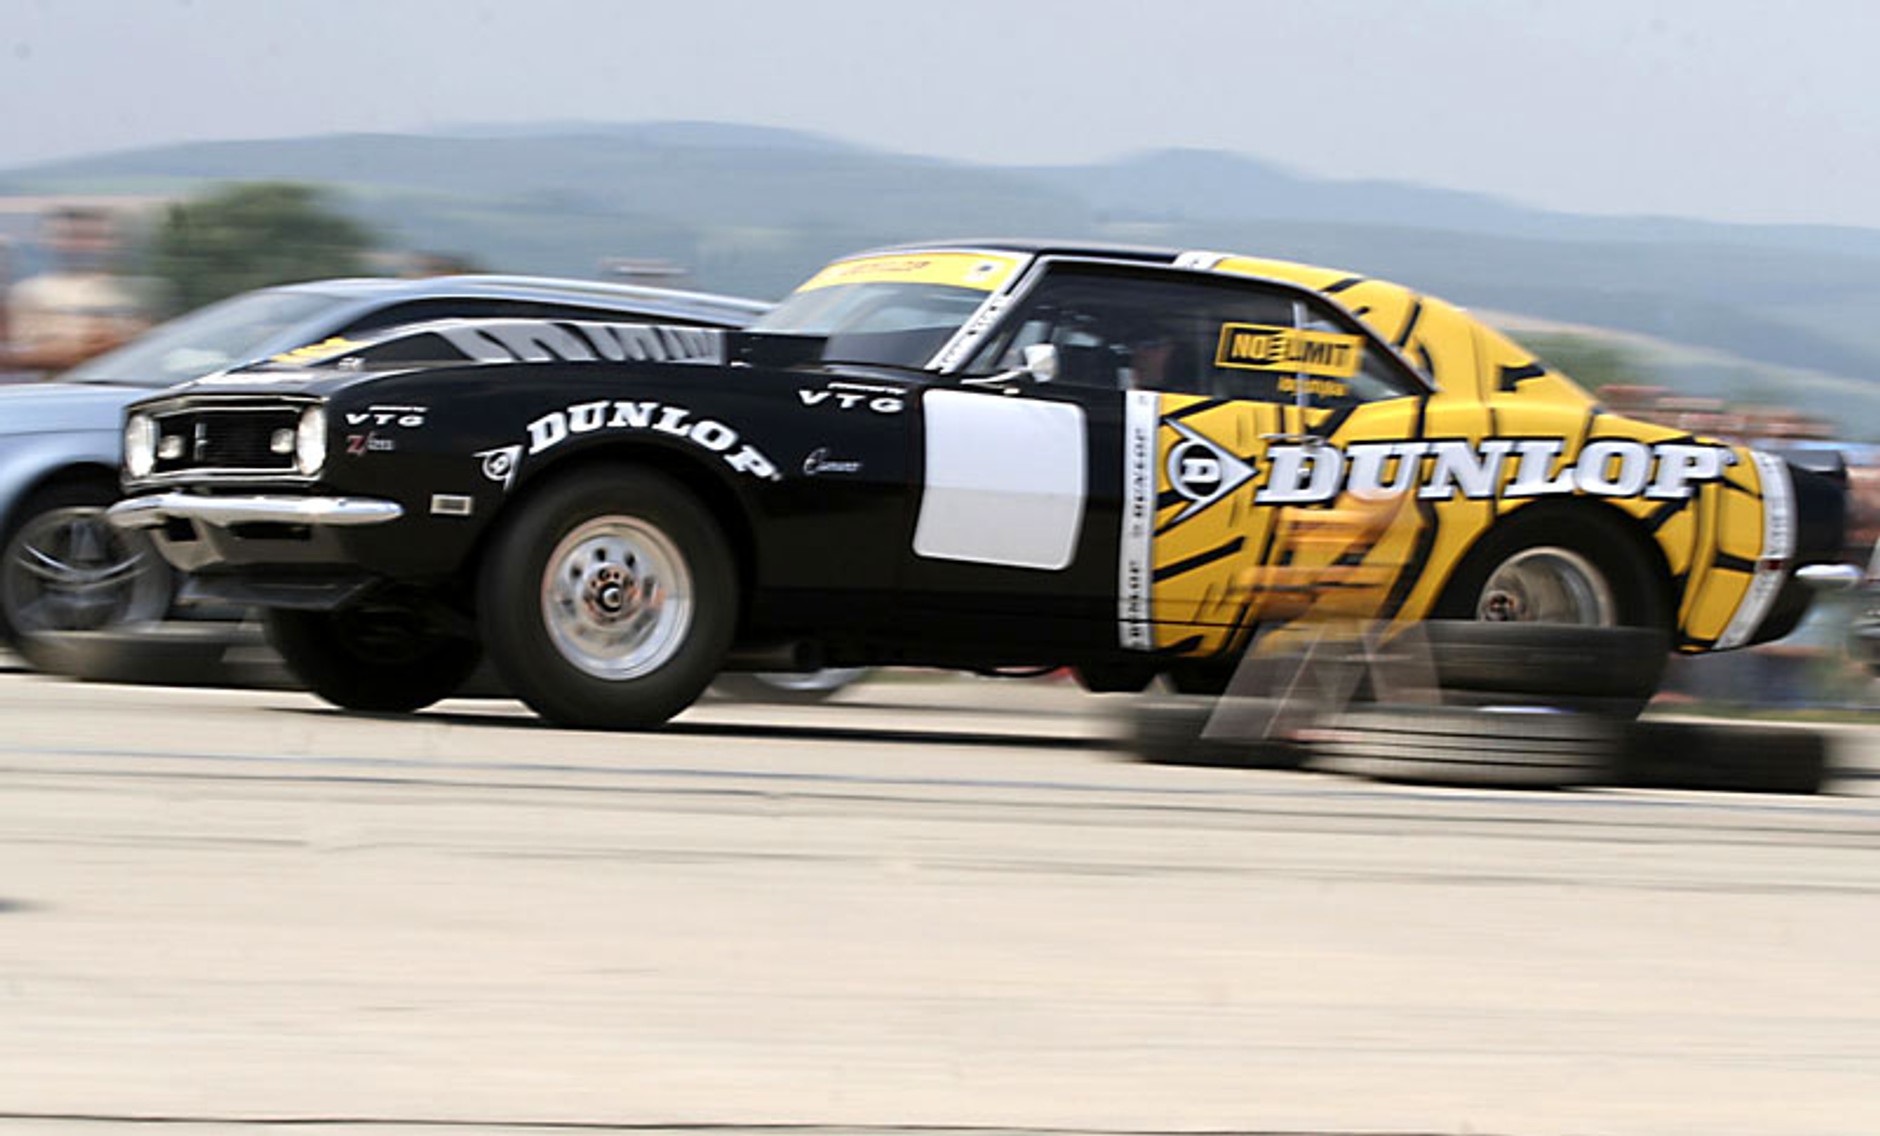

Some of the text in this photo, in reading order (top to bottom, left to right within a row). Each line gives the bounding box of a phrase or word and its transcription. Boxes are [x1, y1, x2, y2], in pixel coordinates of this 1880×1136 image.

[1231, 333, 1268, 360] NO
[798, 389, 905, 413] VTG
[345, 413, 426, 428] VTG
[527, 401, 782, 481] DUNLOP
[1255, 439, 1737, 503] DUNLOP
